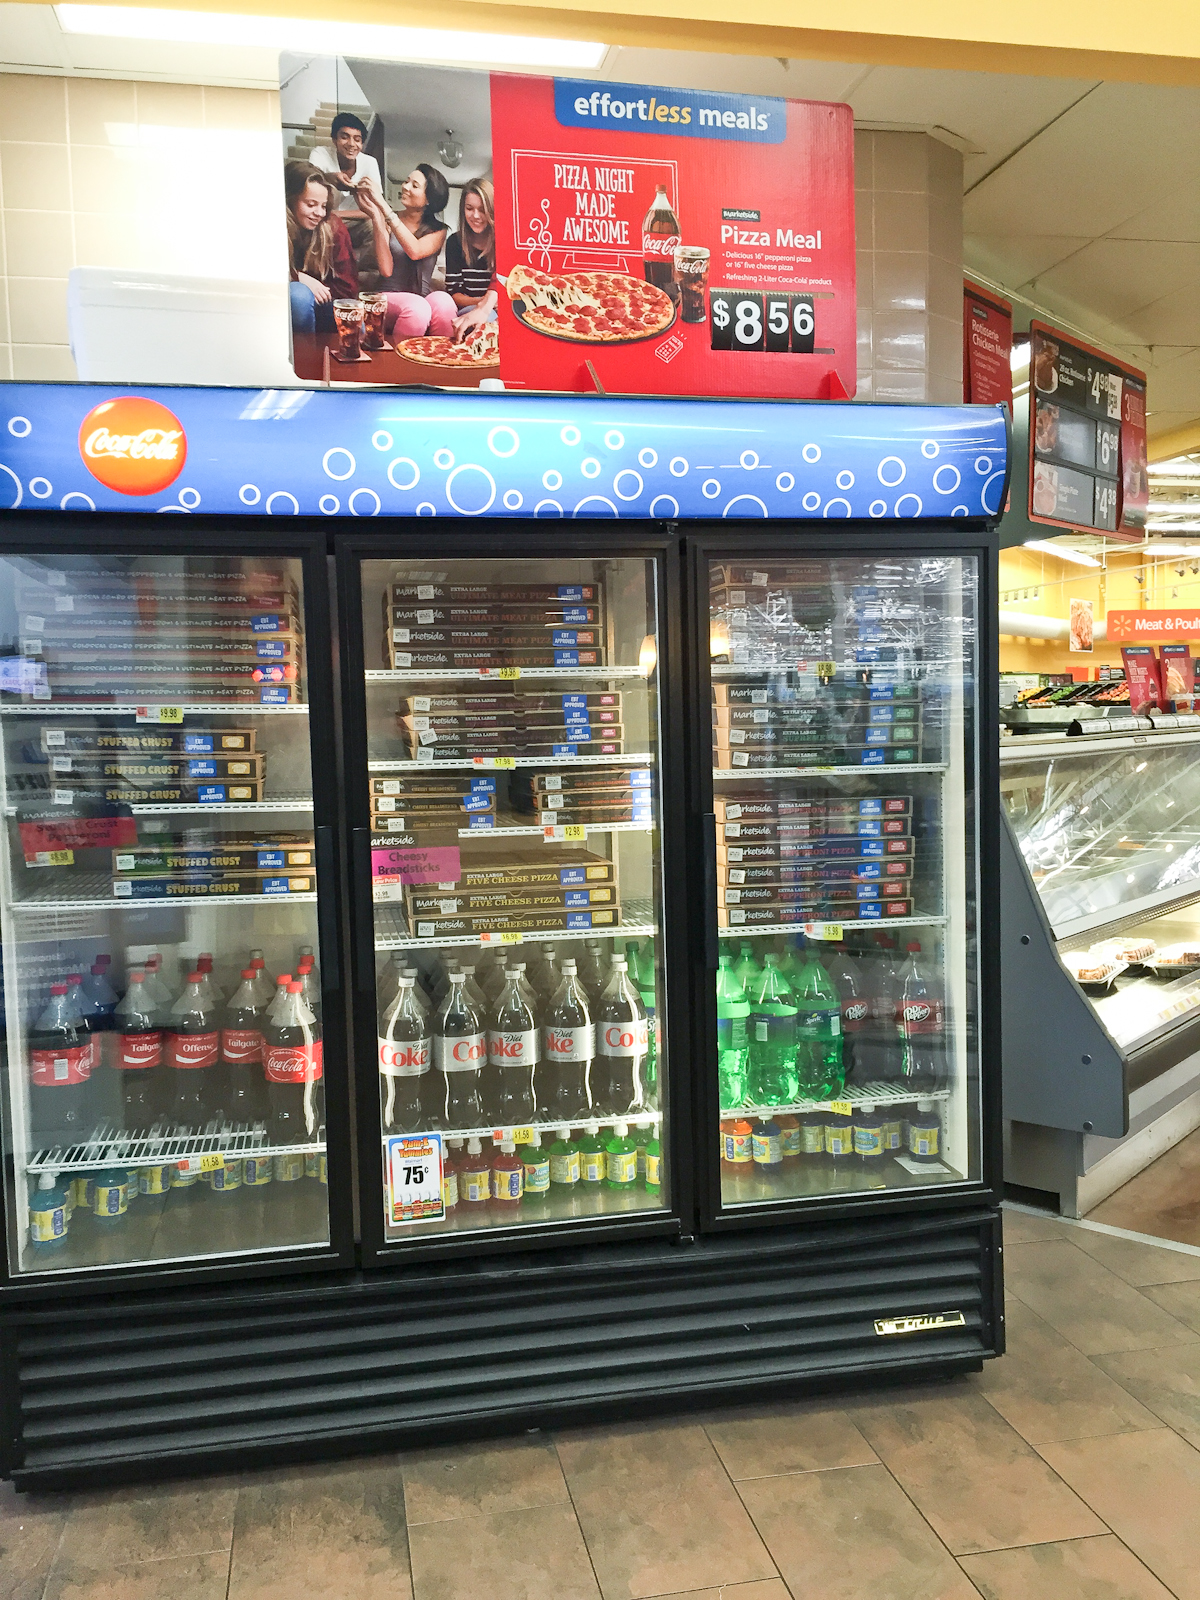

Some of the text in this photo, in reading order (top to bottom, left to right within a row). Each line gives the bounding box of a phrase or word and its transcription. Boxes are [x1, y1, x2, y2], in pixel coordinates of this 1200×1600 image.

[574, 92, 769, 131] effortless meals
[554, 164, 635, 193] PIZZA NIGHT
[575, 192, 616, 218] MADE
[563, 217, 630, 245] AWESOME
[721, 225, 822, 249] Pizza Meal
[725, 251, 753, 259] Delicious
[765, 254, 796, 262] pepperoni
[726, 273, 758, 283] Refreshing
[758, 275, 777, 283] 2-Liter
[808, 278, 832, 286] product
[972, 319, 999, 342] Rotisserie
[972, 333, 996, 353] Chicken
[85, 427, 183, 460] Coca-Cola
[1135, 619, 1163, 631] Meat
[1164, 618, 1174, 631] &
[160, 709, 178, 718] $9.98
[97, 737, 173, 746] STUFFED CRUST
[104, 765, 179, 774] STUFFED CRUST
[105, 790, 181, 800] STUFFED CRUST
[86, 820, 118, 829] Crust
[388, 852, 428, 861] Cheesy
[780, 849, 829, 857] PEPPERONI
[166, 856, 240, 867] STUFFED CRUST
[378, 863, 441, 875] Breadsticks
[466, 873, 559, 885] FIVE CHEESE PIZZA
[166, 883, 240, 894] STUFFED CRUST
[494, 898, 532, 906] CHEESE
[534, 896, 561, 904] PIZZA
[780, 912, 829, 921] PEPPERONI
[472, 919, 563, 930] FIVE CHEESE PIZZA
[911, 1003, 921, 1011] Dr
[848, 1006, 867, 1020] Pepper
[904, 1006, 928, 1021] Pepper
[503, 1033, 522, 1042] Diet
[554, 1029, 572, 1038] Diet
[182, 1043, 213, 1052] Offense
[380, 1044, 429, 1067] Coke
[268, 1056, 306, 1072] Coca-Cola
[514, 1130, 529, 1139] $1.58
